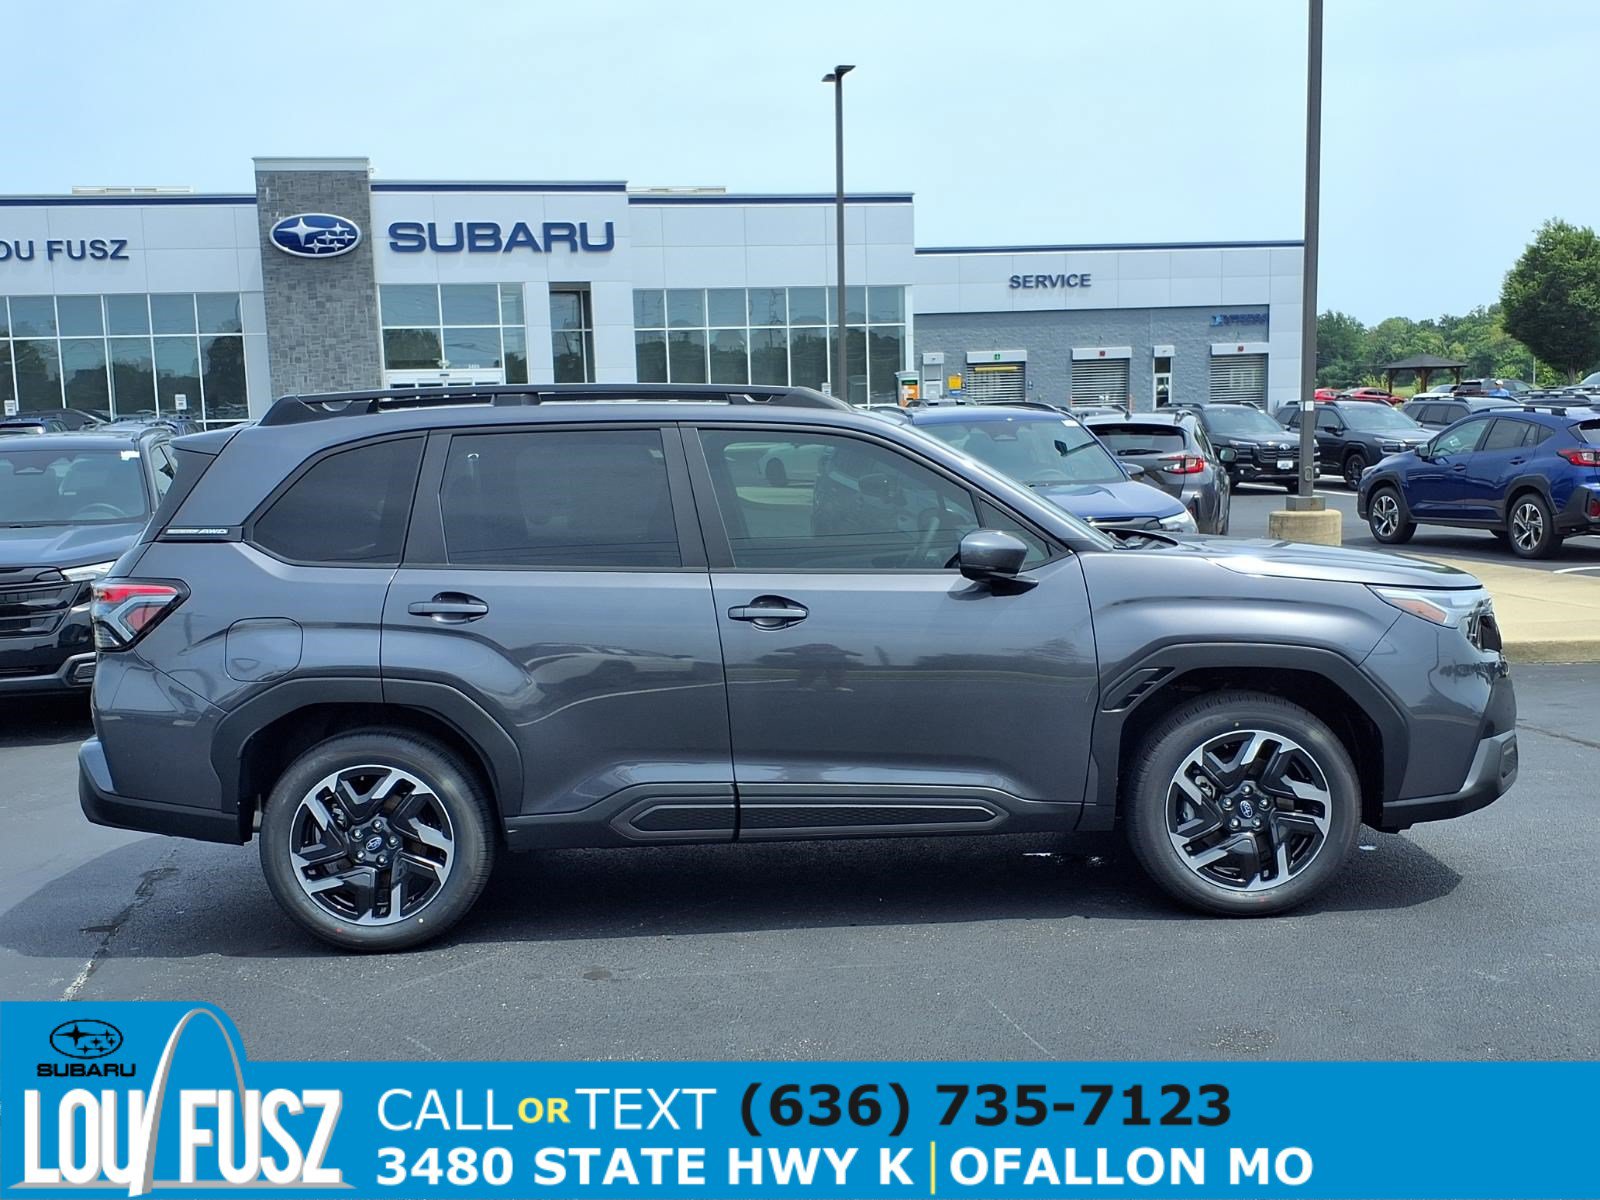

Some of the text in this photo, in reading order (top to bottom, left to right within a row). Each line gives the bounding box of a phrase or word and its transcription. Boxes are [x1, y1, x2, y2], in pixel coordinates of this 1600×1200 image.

[388, 221, 615, 253] SUBARU
[47, 239, 130, 261] FUSZ
[1009, 273, 1092, 290] SERVICE
